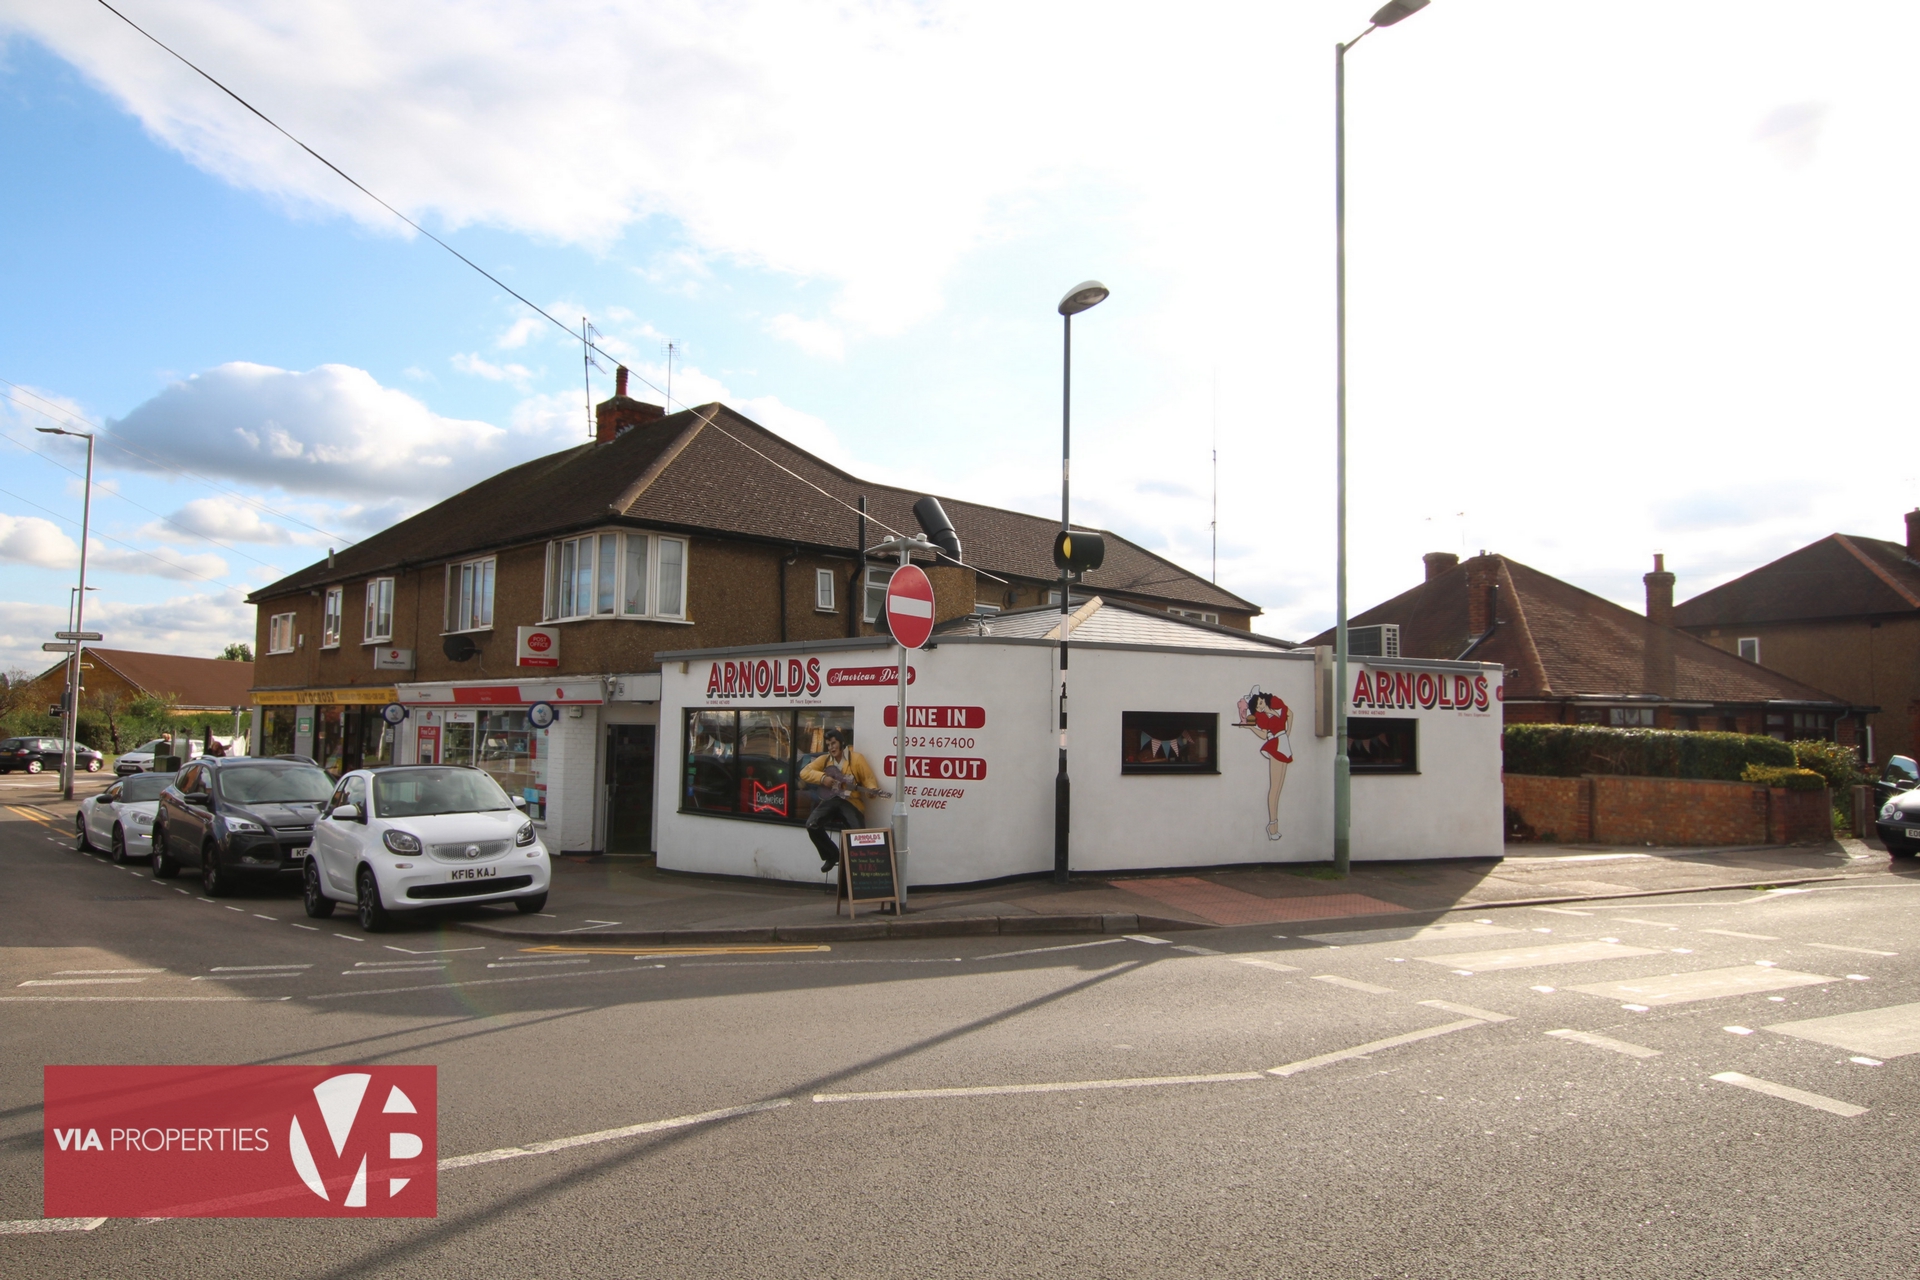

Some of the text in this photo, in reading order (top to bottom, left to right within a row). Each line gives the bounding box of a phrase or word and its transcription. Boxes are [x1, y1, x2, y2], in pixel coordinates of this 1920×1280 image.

[706, 657, 822, 699] ARNOLDS
[829, 667, 913, 684] American Dinr
[296, 691, 335, 703] AUTOCROSS
[1352, 670, 1490, 712] ARNOLDS
[906, 708, 966, 727] INE IN
[420, 727, 436, 735] Free Cash
[893, 737, 975, 749] 0992 467400
[889, 758, 981, 778] TKE OUT
[756, 791, 785, 805] Budweiser
[904, 786, 964, 799] REE DELIVERY
[910, 798, 947, 810] SERVICE
[451, 867, 497, 880] KF16 KAJ
